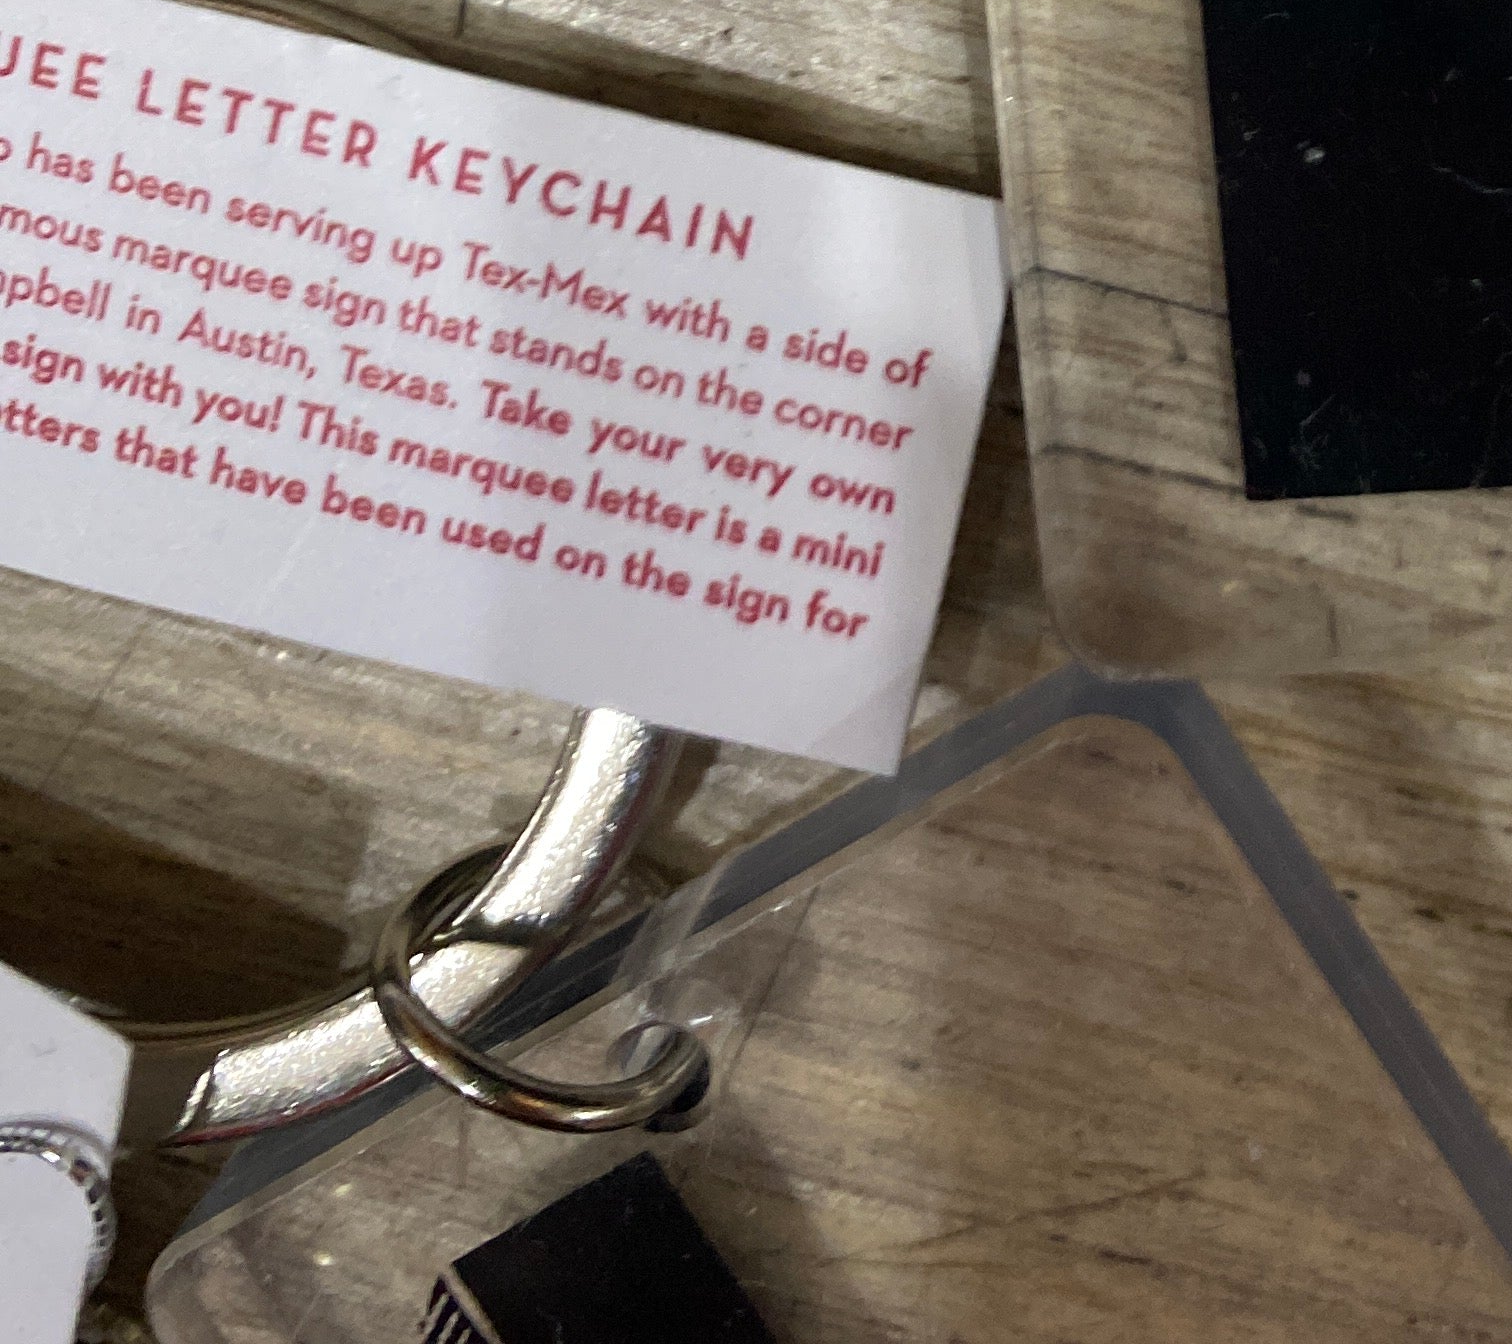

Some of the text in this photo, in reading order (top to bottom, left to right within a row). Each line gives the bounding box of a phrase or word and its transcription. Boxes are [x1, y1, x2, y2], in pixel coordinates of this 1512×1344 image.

[26, 131, 94, 185] has
[108, 152, 209, 212] been
[226, 197, 374, 264] serving
[390, 239, 441, 277] up
[466, 243, 627, 315] Tex-Mex
[647, 299, 730, 342] with
[745, 325, 769, 352] a
[784, 334, 869, 374] side
[885, 348, 932, 387] of
[137, 69, 377, 167] LETTER
[408, 137, 753, 259] KEYCHAIN
[1, 333, 885, 577] sign with you! This marquee letter is a mini
[116, 235, 292, 301] marquee
[303, 277, 385, 329] sign
[399, 299, 479, 346] that
[491, 329, 622, 383] stands
[634, 366, 684, 395] on
[697, 373, 763, 415] the
[774, 397, 914, 451] corner
[126, 294, 161, 334] in
[178, 310, 317, 380] Austin,
[342, 345, 458, 408] Texas.
[482, 379, 573, 437] Take
[587, 421, 685, 461] your
[703, 447, 793, 498] very
[809, 474, 896, 515] own
[0, 399, 868, 638] tters that have been used on the sign for
